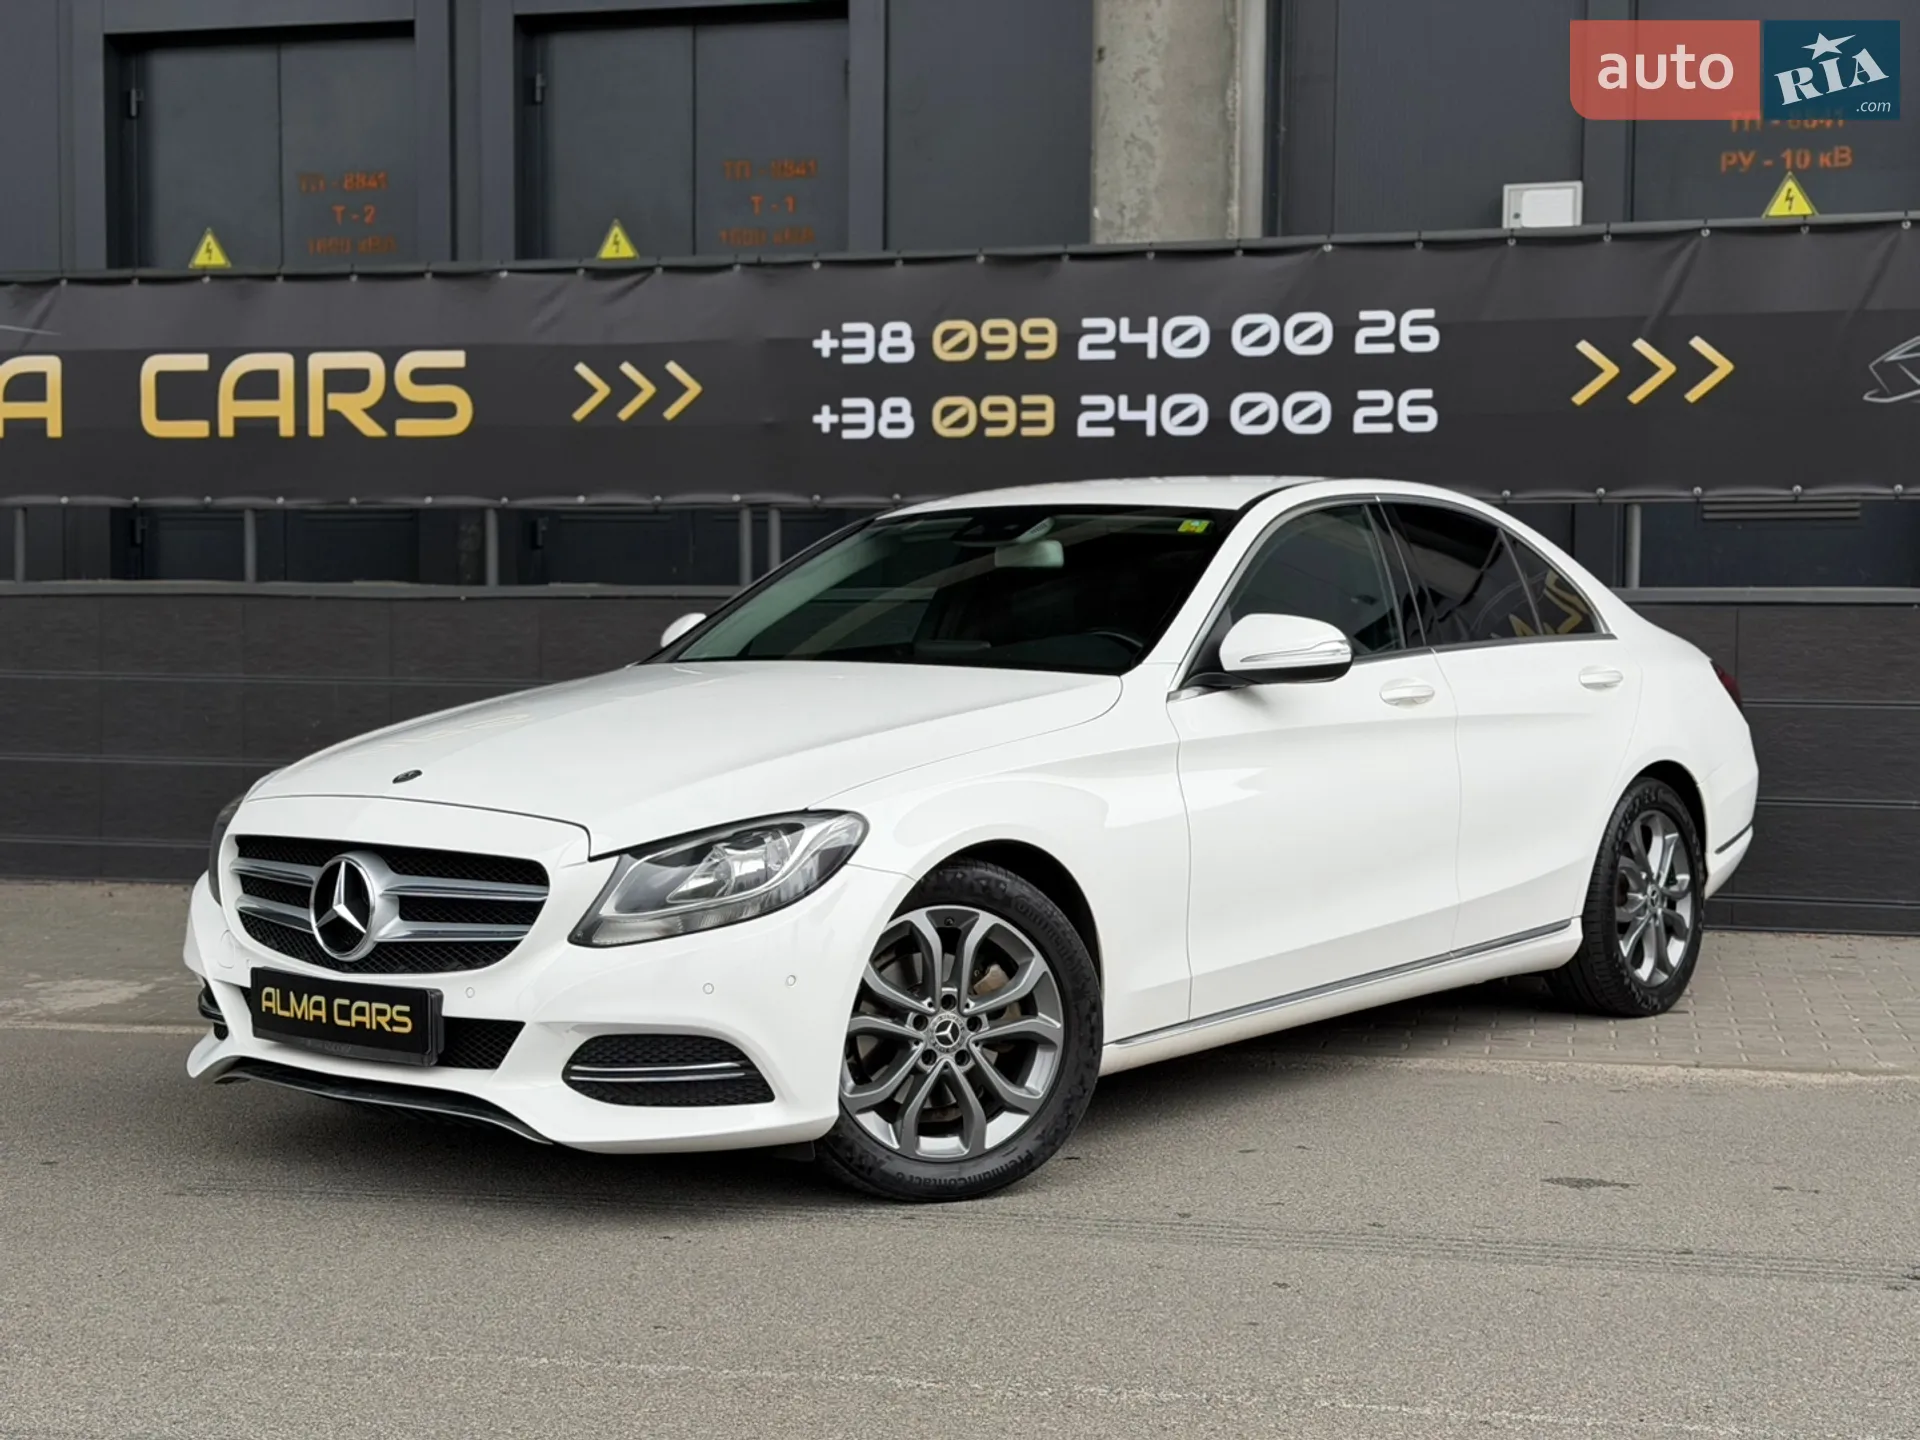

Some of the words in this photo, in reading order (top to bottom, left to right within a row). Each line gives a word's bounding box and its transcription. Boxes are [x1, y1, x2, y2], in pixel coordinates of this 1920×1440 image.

[1781, 148, 1811, 170] 10
[813, 321, 916, 364] +38
[932, 318, 1058, 362] 099
[1077, 315, 1211, 361] 240
[1230, 312, 1334, 357] 00
[1354, 308, 1440, 355] 26
[140, 349, 474, 438] CARS
[812, 396, 915, 439] +38
[931, 395, 1055, 438] 093
[1076, 393, 1209, 438] 240
[1229, 391, 1332, 435] 00
[1352, 388, 1439, 434] 26
[261, 986, 327, 1024] ALMA
[333, 998, 413, 1034] CARS
